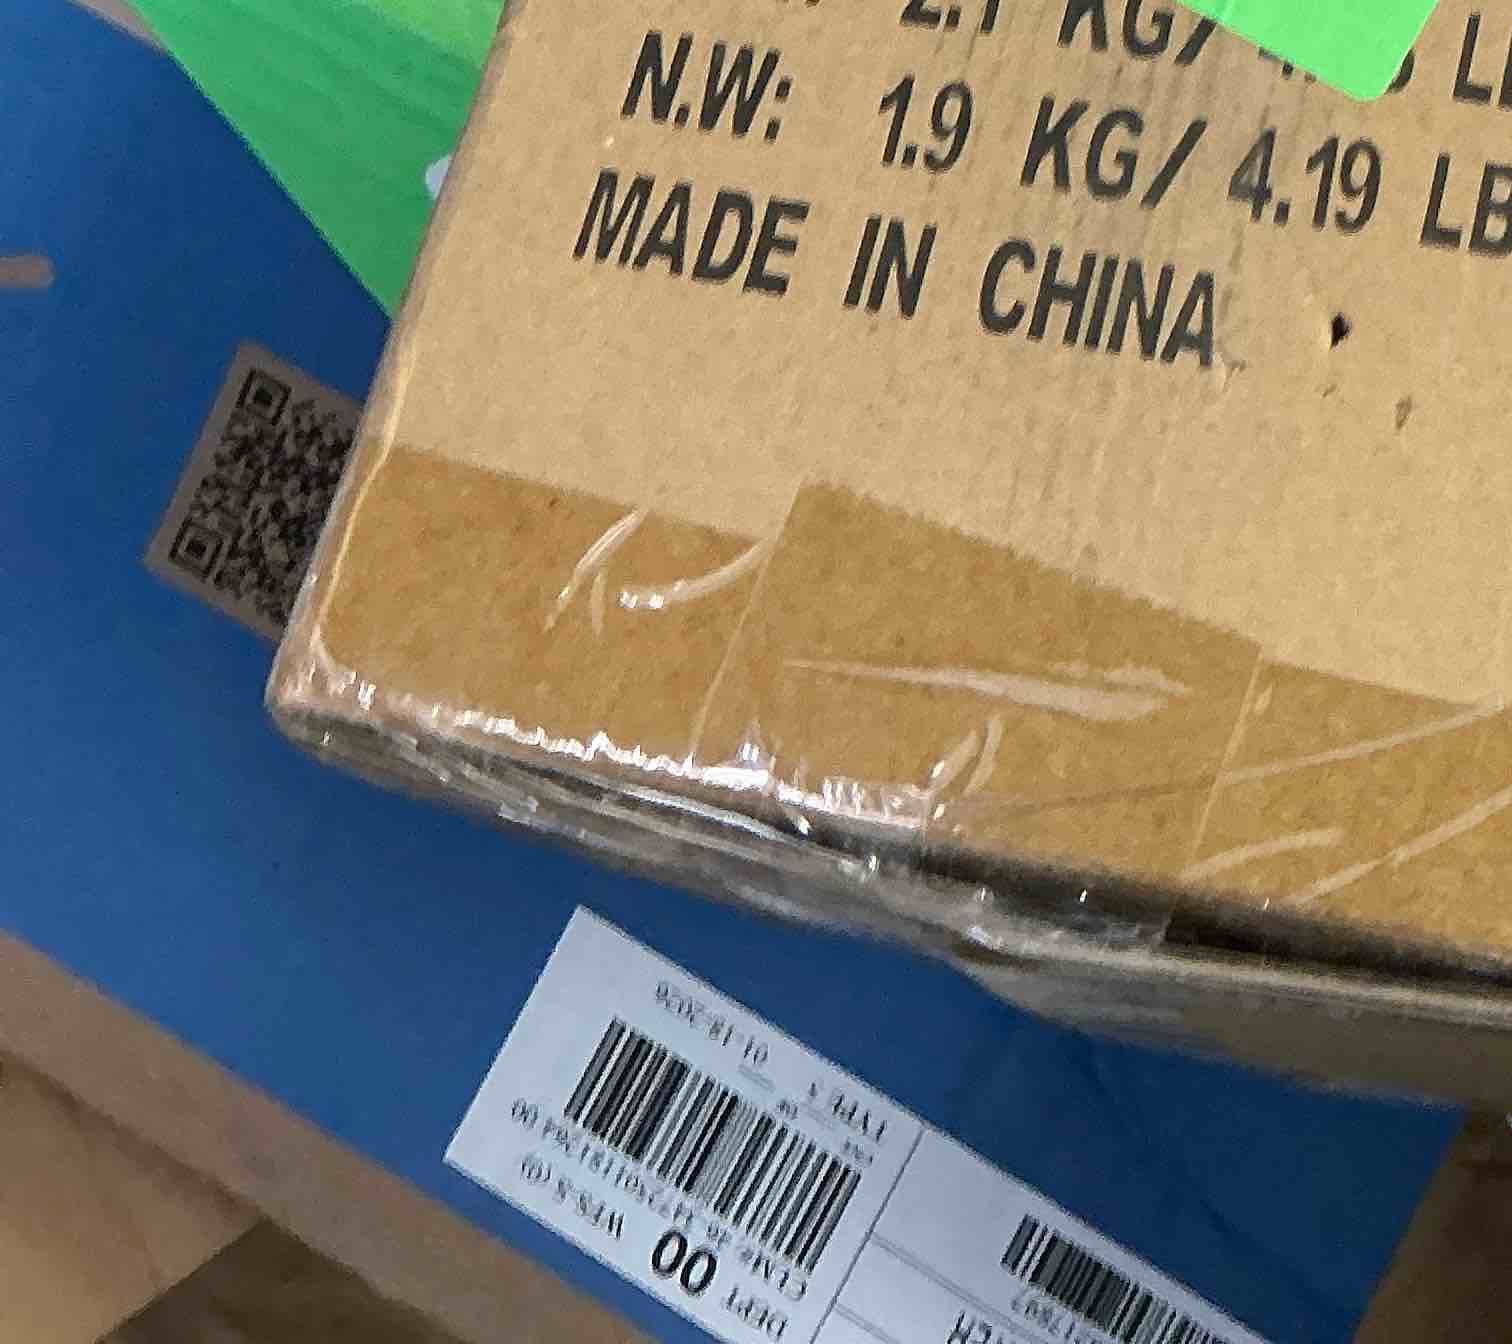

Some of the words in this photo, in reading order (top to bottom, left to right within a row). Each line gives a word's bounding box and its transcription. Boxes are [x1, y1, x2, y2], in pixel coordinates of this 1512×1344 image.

[622, 30, 792, 143] N.W:
[877, 73, 971, 173] 1.9
[1022, 94, 1208, 210] KG/
[1229, 134, 1383, 237] 4.19
[573, 167, 807, 298] MADE
[844, 215, 938, 319] IN
[980, 239, 1217, 368] CHINA
[649, 1230, 718, 1298] 00
